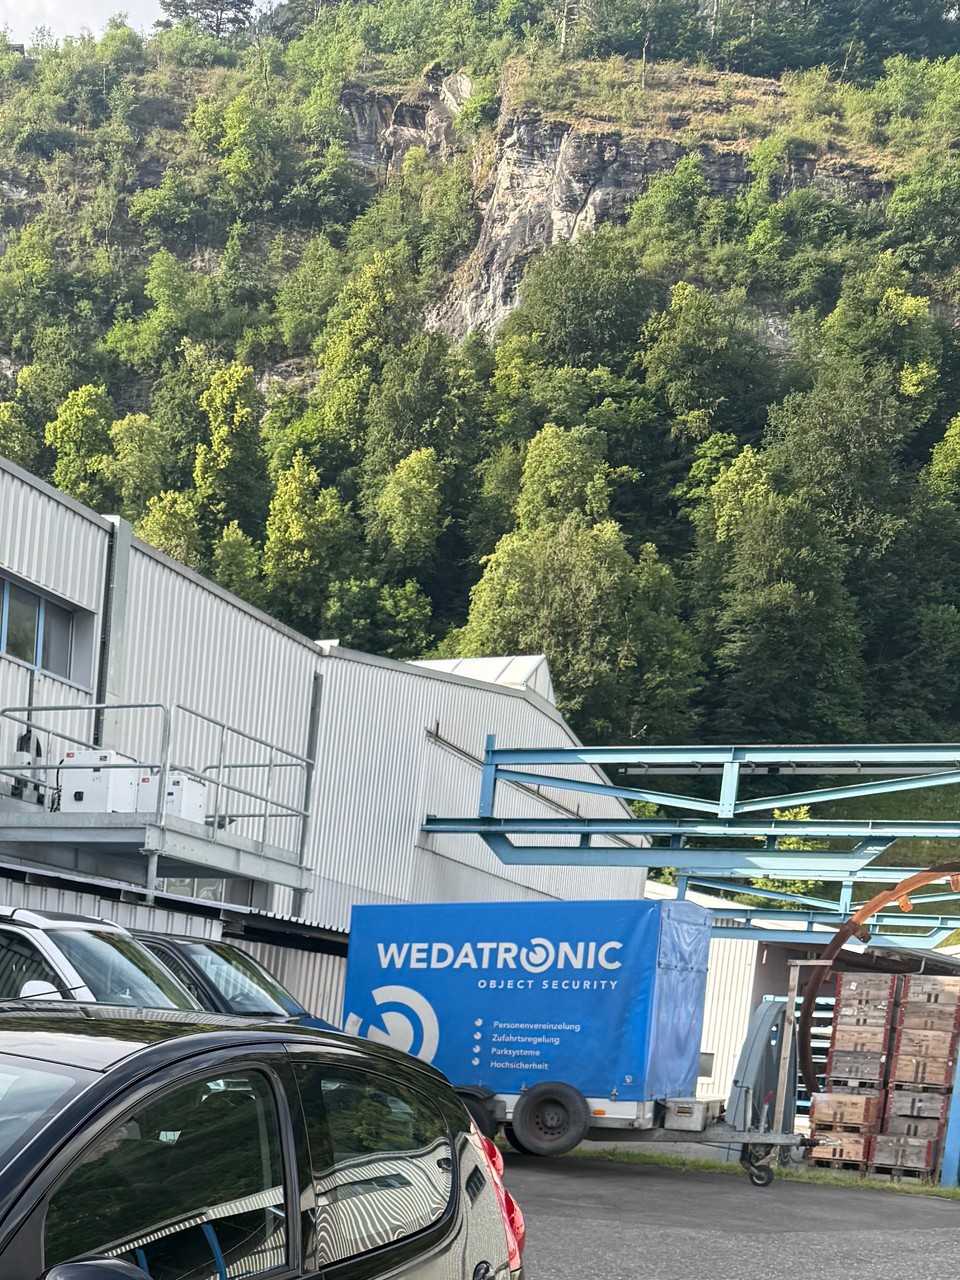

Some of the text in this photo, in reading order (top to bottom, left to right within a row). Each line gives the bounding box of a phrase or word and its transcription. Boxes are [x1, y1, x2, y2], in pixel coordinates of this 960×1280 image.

[377, 938, 623, 974] WEDATRONIC
[477, 979, 618, 990] OBJECT SECURITY
[493, 1021, 581, 1032] Personenvereinzelung
[492, 1034, 560, 1046] Zufahrtsregelung
[491, 1047, 540, 1058] Parksysteme
[490, 1060, 549, 1070] Hochsicherheit
